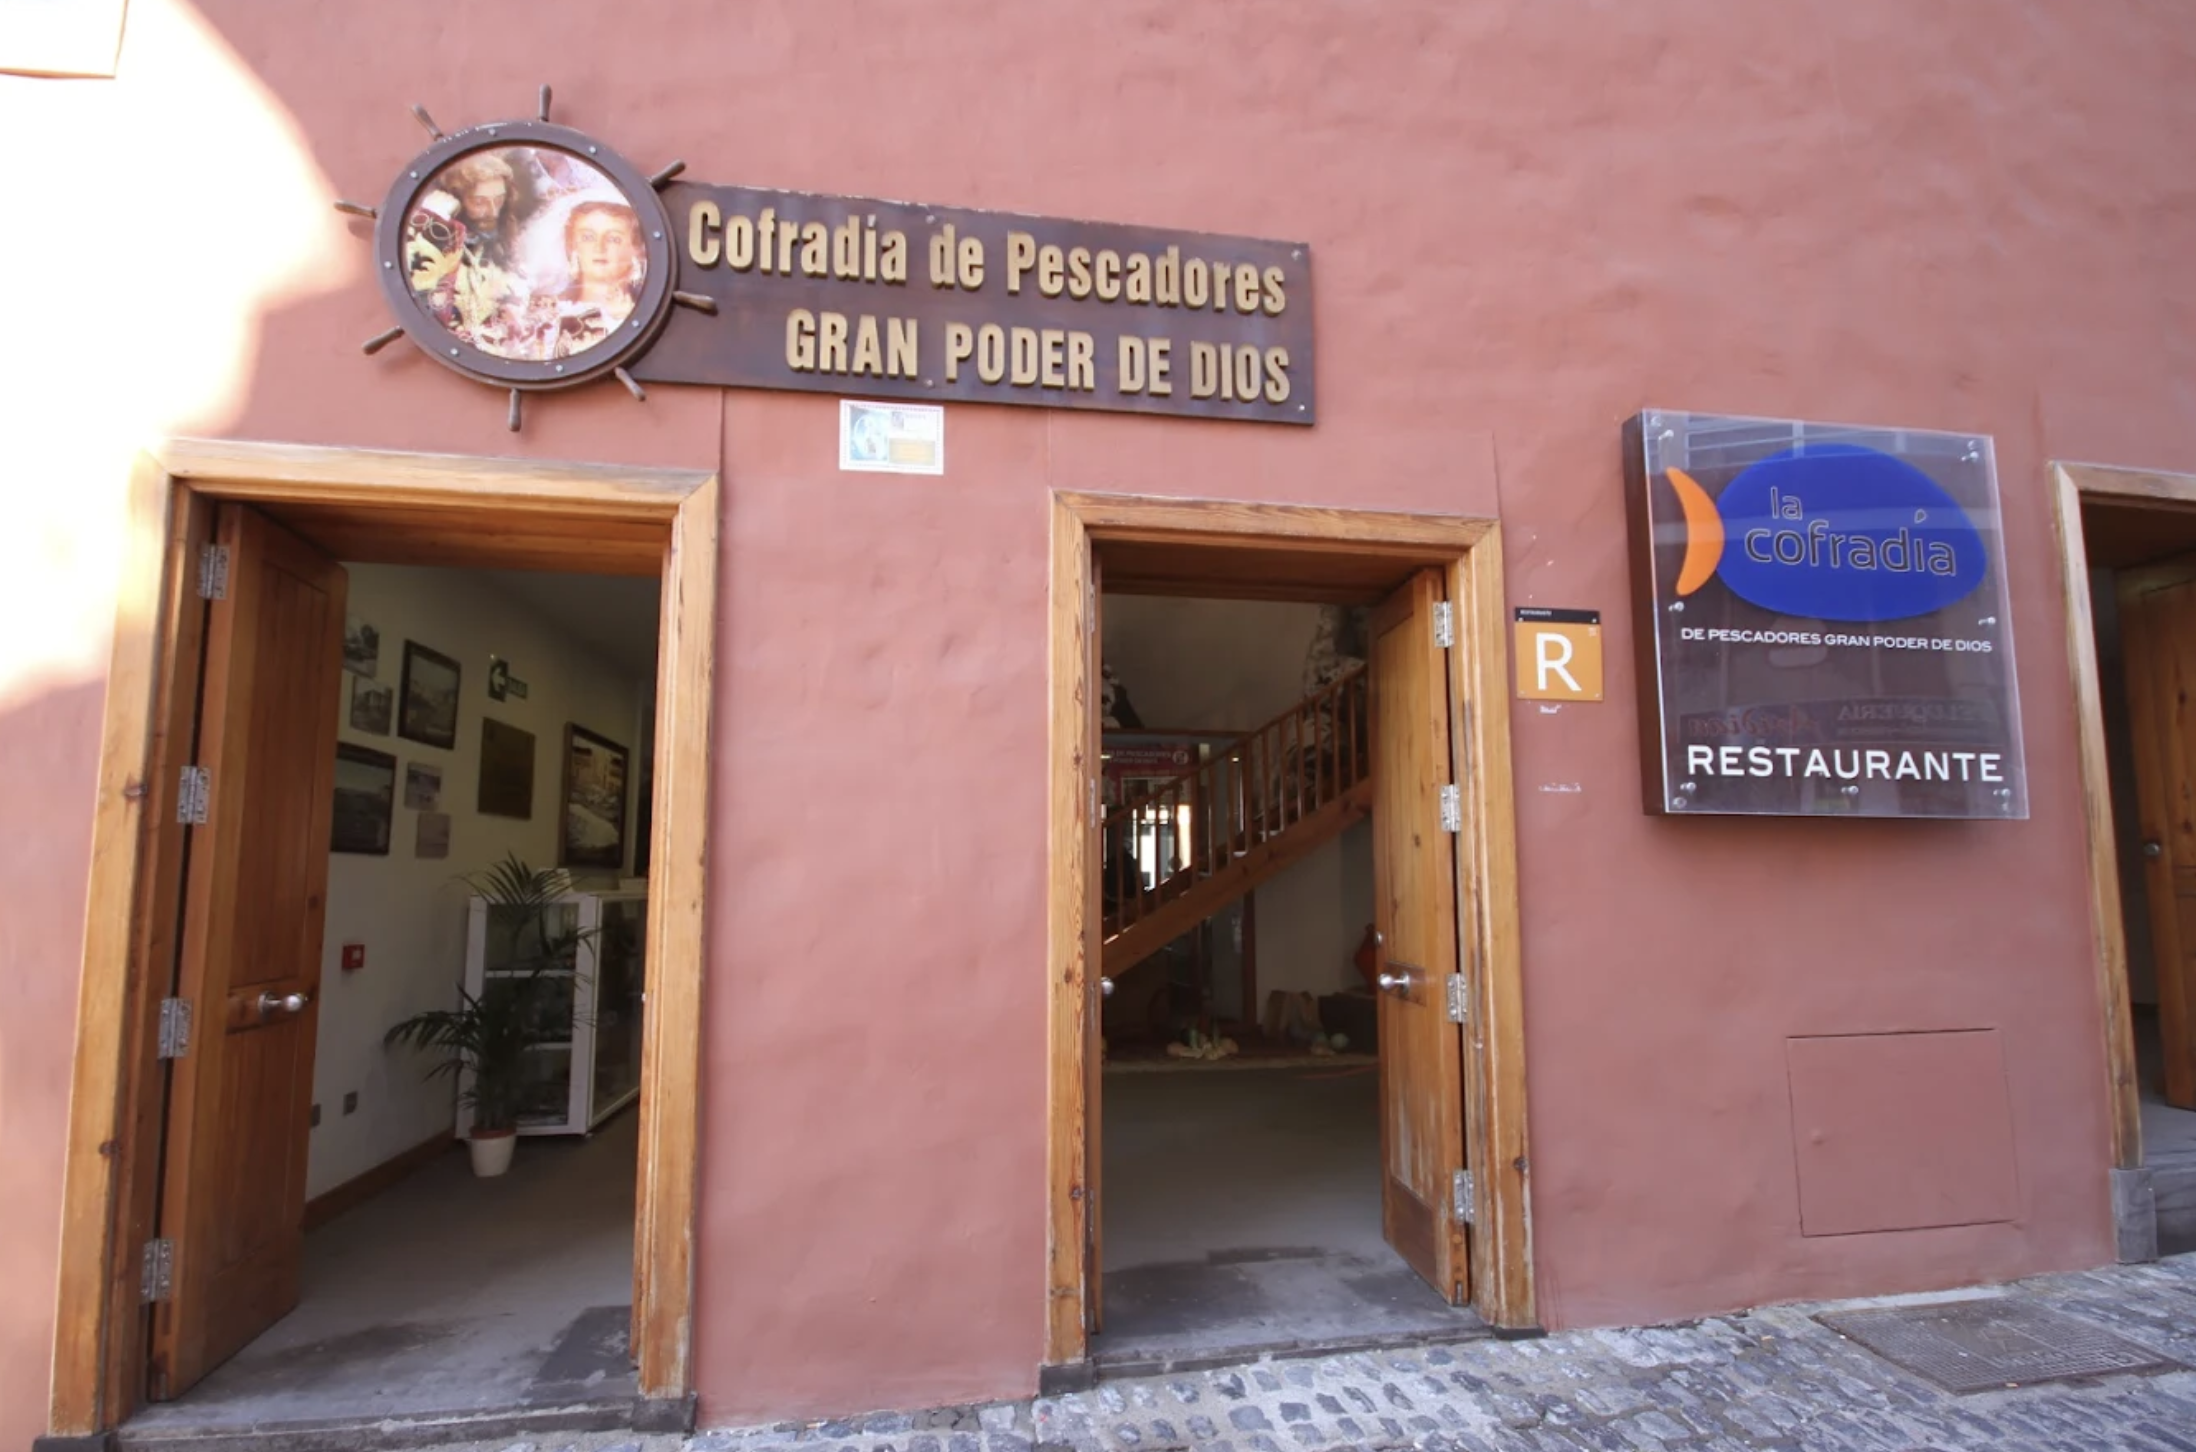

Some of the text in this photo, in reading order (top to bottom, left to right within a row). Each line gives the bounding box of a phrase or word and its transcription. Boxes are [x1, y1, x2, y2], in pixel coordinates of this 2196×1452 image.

[929, 223, 985, 290] de
[1007, 230, 1287, 316] Pescadores
[785, 308, 1291, 404] GRAN PODER DE DIOS
[1770, 486, 1803, 521] la
[1744, 509, 1957, 577] cofradía
[1535, 632, 1582, 692] R
[1681, 628, 1992, 652] DE PESCADORES GRAN PODER DE DIOS
[1687, 745, 2004, 782] RESTAURANTE
